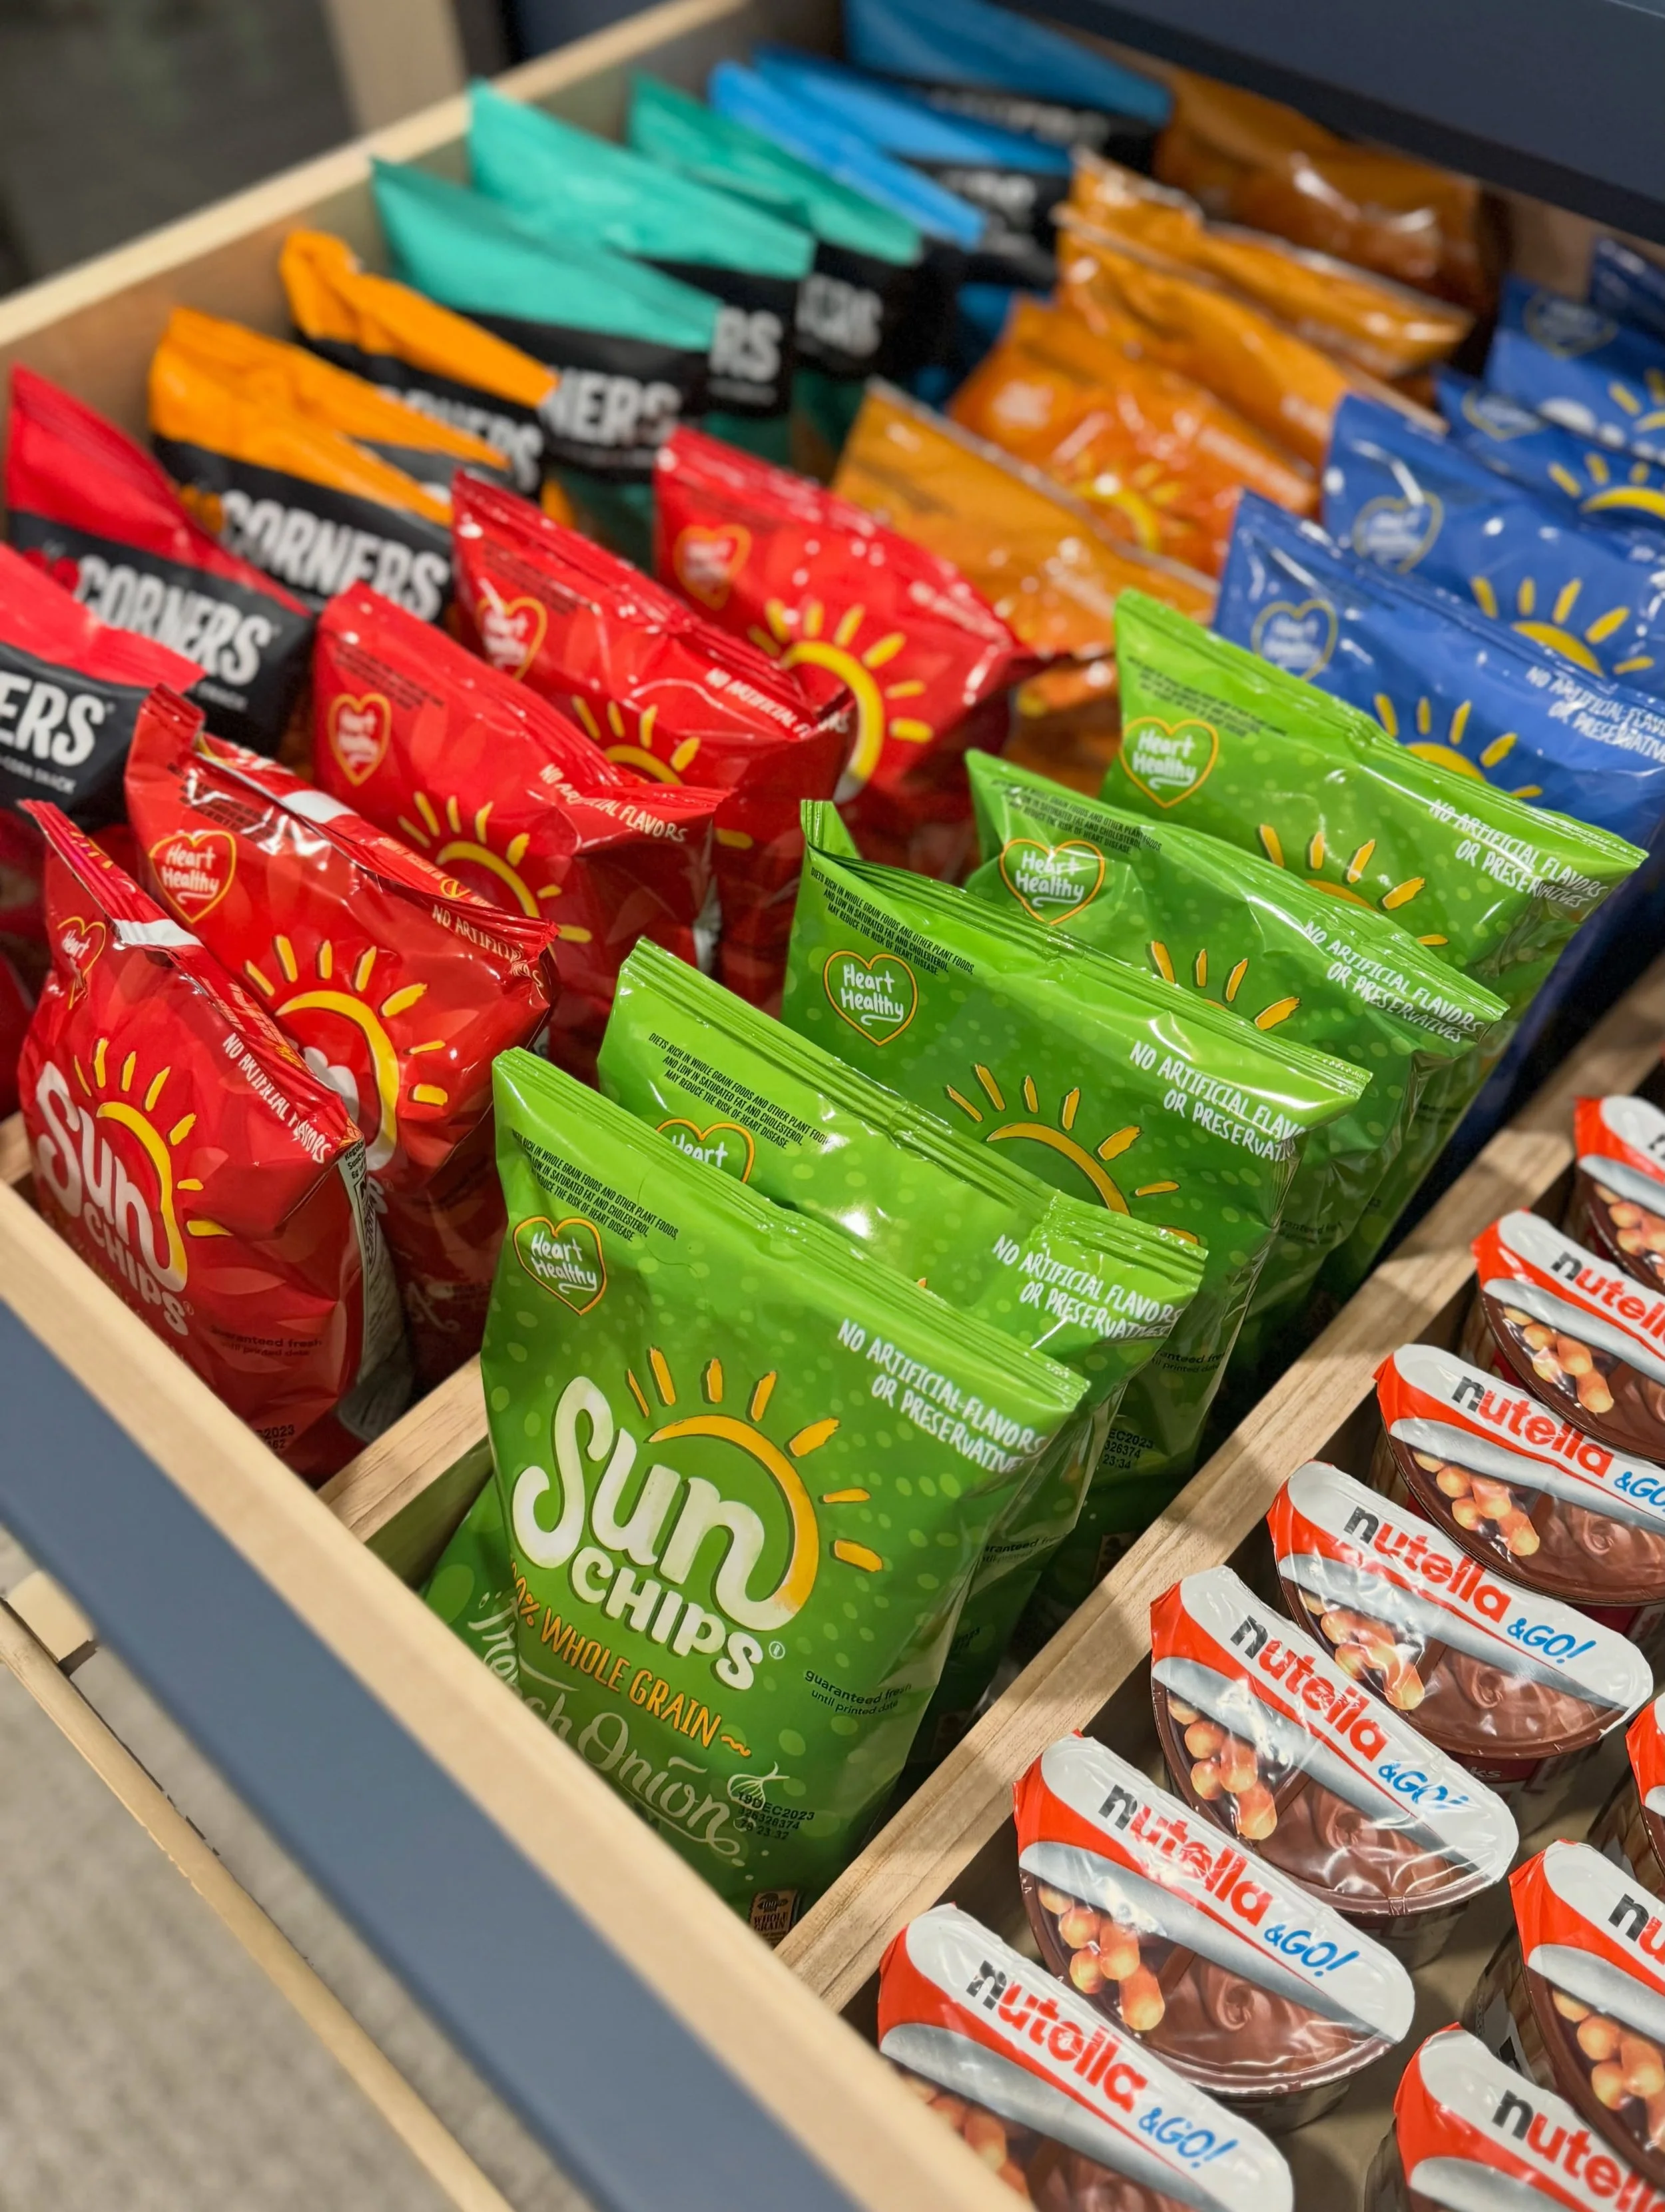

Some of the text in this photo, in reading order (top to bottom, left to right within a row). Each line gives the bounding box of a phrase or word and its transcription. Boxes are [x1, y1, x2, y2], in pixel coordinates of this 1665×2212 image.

[1132, 750, 1197, 790] Healthy
[1138, 730, 1195, 759] Heart
[539, 763, 689, 843] NO FLAVORS
[1073, 814, 1085, 827] FAT
[1084, 819, 1098, 833] AND
[1074, 826, 1084, 837] OF
[1083, 829, 1104, 845] HEART
[1104, 815, 1124, 831] OTHER
[166, 844, 216, 871] Heart
[1021, 850, 1080, 876] Heart
[1429, 799, 1608, 898] NO ARTIFICIAL FLAVORS
[1455, 839, 1589, 908] OR PRESERVATIVES
[162, 867, 220, 904] Healthy
[432, 905, 451, 928] NO
[1015, 870, 1084, 907] Healthy
[811, 867, 974, 975] DIETS RICH IN WHOLE GRAIN FOODS AND OTHER PLANT FOODS,
[823, 887, 949, 972] AND LOW IN SATURATED FAT AND CHOLESTEROL,
[827, 903, 839, 919] MAY
[838, 911, 860, 931] REDUCE
[859, 924, 872, 937] THE
[870, 931, 885, 947] RISK
[884, 940, 894, 952] OF
[893, 944, 914, 963] HEART
[840, 987, 904, 1026] Healthy
[842, 962, 895, 994] Heart
[1303, 922, 1485, 1032] NO ARTIFICIAL FLAVORS
[1326, 961, 1463, 1044] OR PRESERVATIVES
[222, 1032, 244, 1059] NO
[649, 1032, 813, 1134] DIETS RICH IN WHOLE GRAIN FOODS AND OTHER PLANT
[663, 1055, 804, 1147] AND LOW IN SATURATED FAT AND CHOLESTEROL,
[664, 1069, 790, 1150] MAY REDUCE THE RISK OF HEART DISEASE.
[1129, 1040, 1251, 1123] NO ARTIFICIAL
[1164, 1089, 1187, 1118] OR
[37, 1060, 187, 1292] Sun
[534, 1145, 543, 1157] IN
[541, 1149, 564, 1170] WHOLE
[562, 1162, 581, 1181] GRAIN
[581, 1174, 602, 1192] FOODS
[601, 1186, 617, 1201] AND
[615, 1194, 637, 1213] OTHER
[636, 1207, 657, 1226] PLANT
[655, 1220, 679, 1240] FOODS,
[543, 1165, 552, 1177] IN
[550, 1168, 584, 1196] SATURATED
[582, 1188, 596, 1204] FAT
[594, 1196, 609, 1211] AND
[607, 1204, 650, 1238] CHOLESTEROL,
[531, 1231, 583, 1262] Heart
[554, 1186, 635, 1242] THE RISK OF HEART DISEASE.
[84, 1202, 189, 1335] CHIPS
[531, 1256, 597, 1294] Healthy
[992, 1234, 1020, 1266] NO
[1018, 1250, 1104, 1301] ARTIFICIAL
[1019, 1280, 1045, 1309] OR
[836, 1318, 1048, 1454] NO ARTIFICIAL FLAVORS
[870, 1374, 898, 1409] OR
[1452, 1376, 1614, 1479] nutella
[513, 1376, 803, 1631] Sun
[571, 1546, 763, 1690] CHIPS
[1343, 1506, 1596, 1664] nutella &GO!
[540, 1607, 631, 1692] WHOLE
[628, 1668, 723, 1749] GRAIN
[805, 1670, 912, 1705] guaranteed fresh
[811, 1689, 898, 1716] until printed date
[1230, 1615, 1388, 1762] nutella
[577, 1712, 737, 1854] Onion
[738, 1791, 815, 1821] 19DEC2023
[1098, 1784, 1361, 1977] nutella &GO!
[966, 1960, 1238, 2168] nutella &GO!
